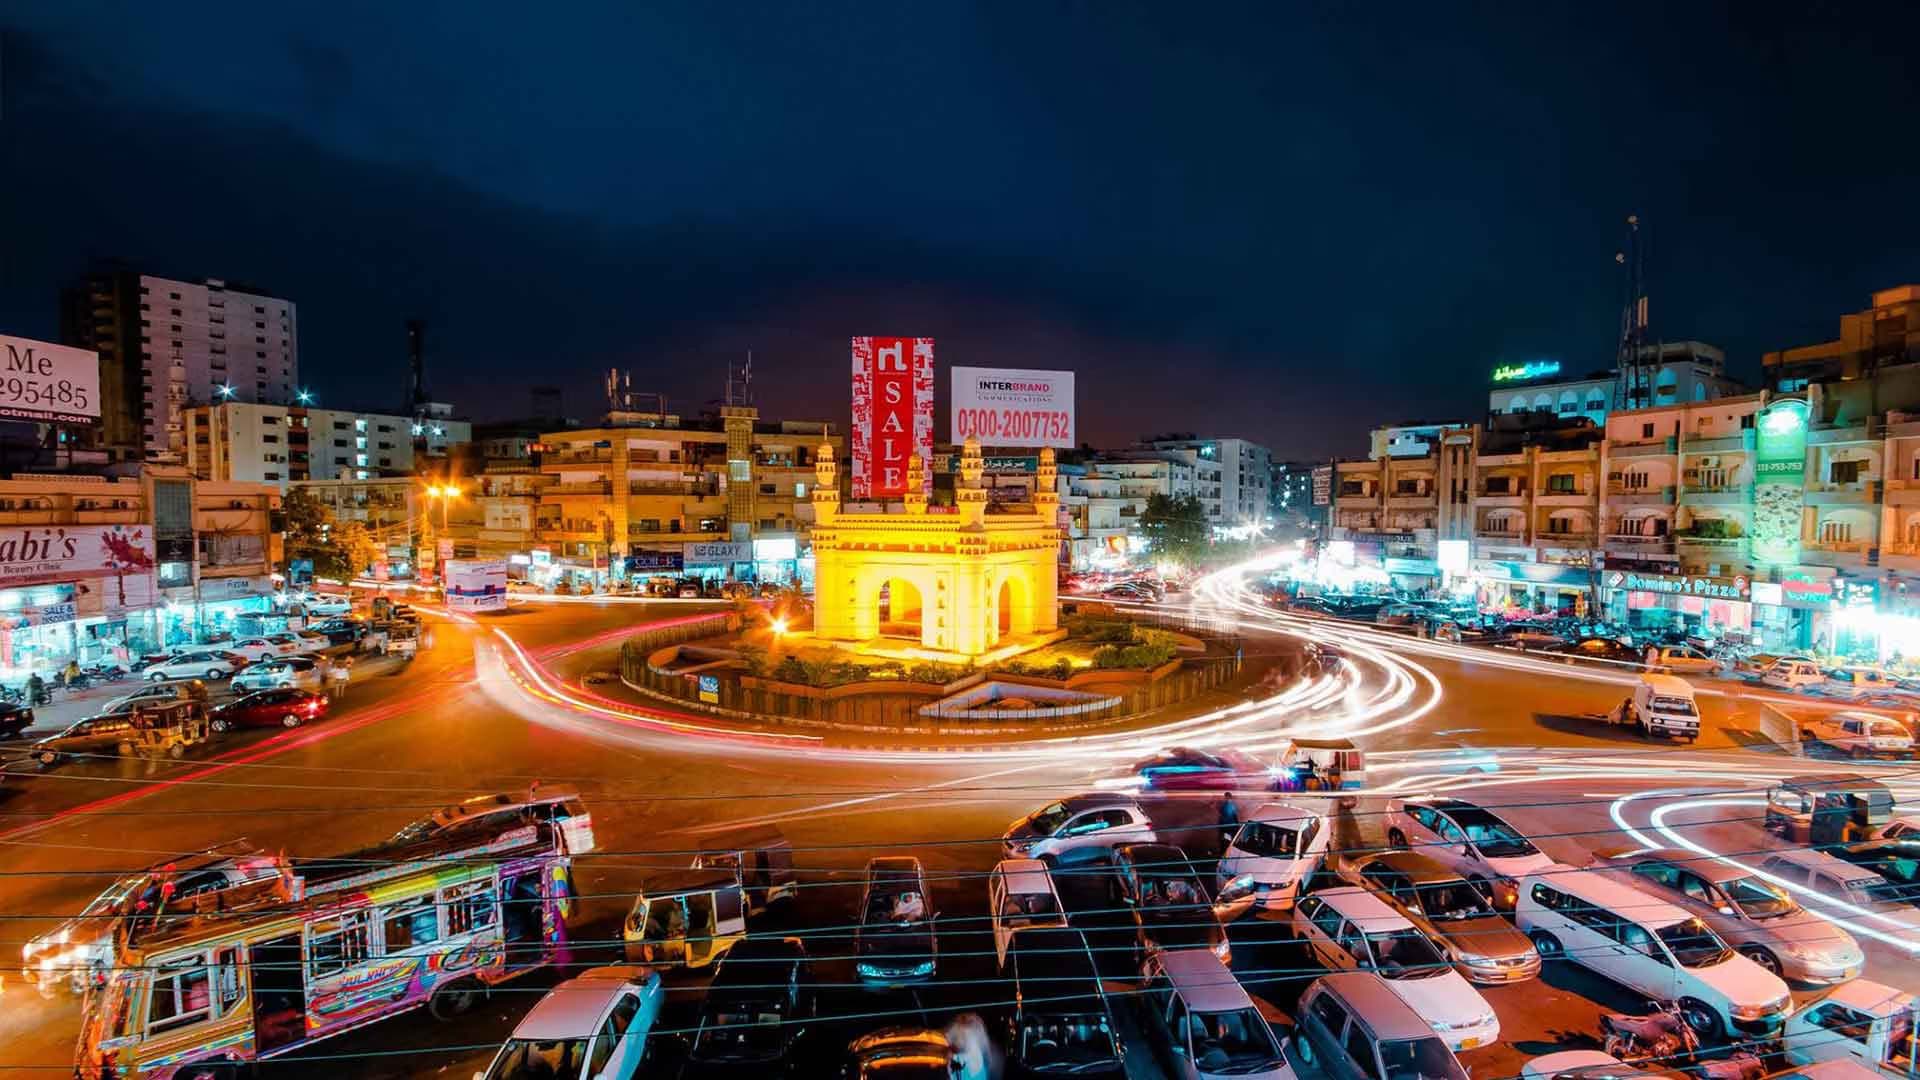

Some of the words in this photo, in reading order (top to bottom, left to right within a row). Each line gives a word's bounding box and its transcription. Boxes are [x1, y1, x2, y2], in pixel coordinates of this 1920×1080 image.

[6, 343, 53, 376] Me
[979, 381, 1050, 392] INTERBRAND
[881, 380, 904, 489] SALE
[958, 408, 1069, 440] 0300-2007752
[1627, 574, 1692, 593] Domino's
[1694, 578, 1740, 597] Pizza
[43, 605, 65, 616] SALE
